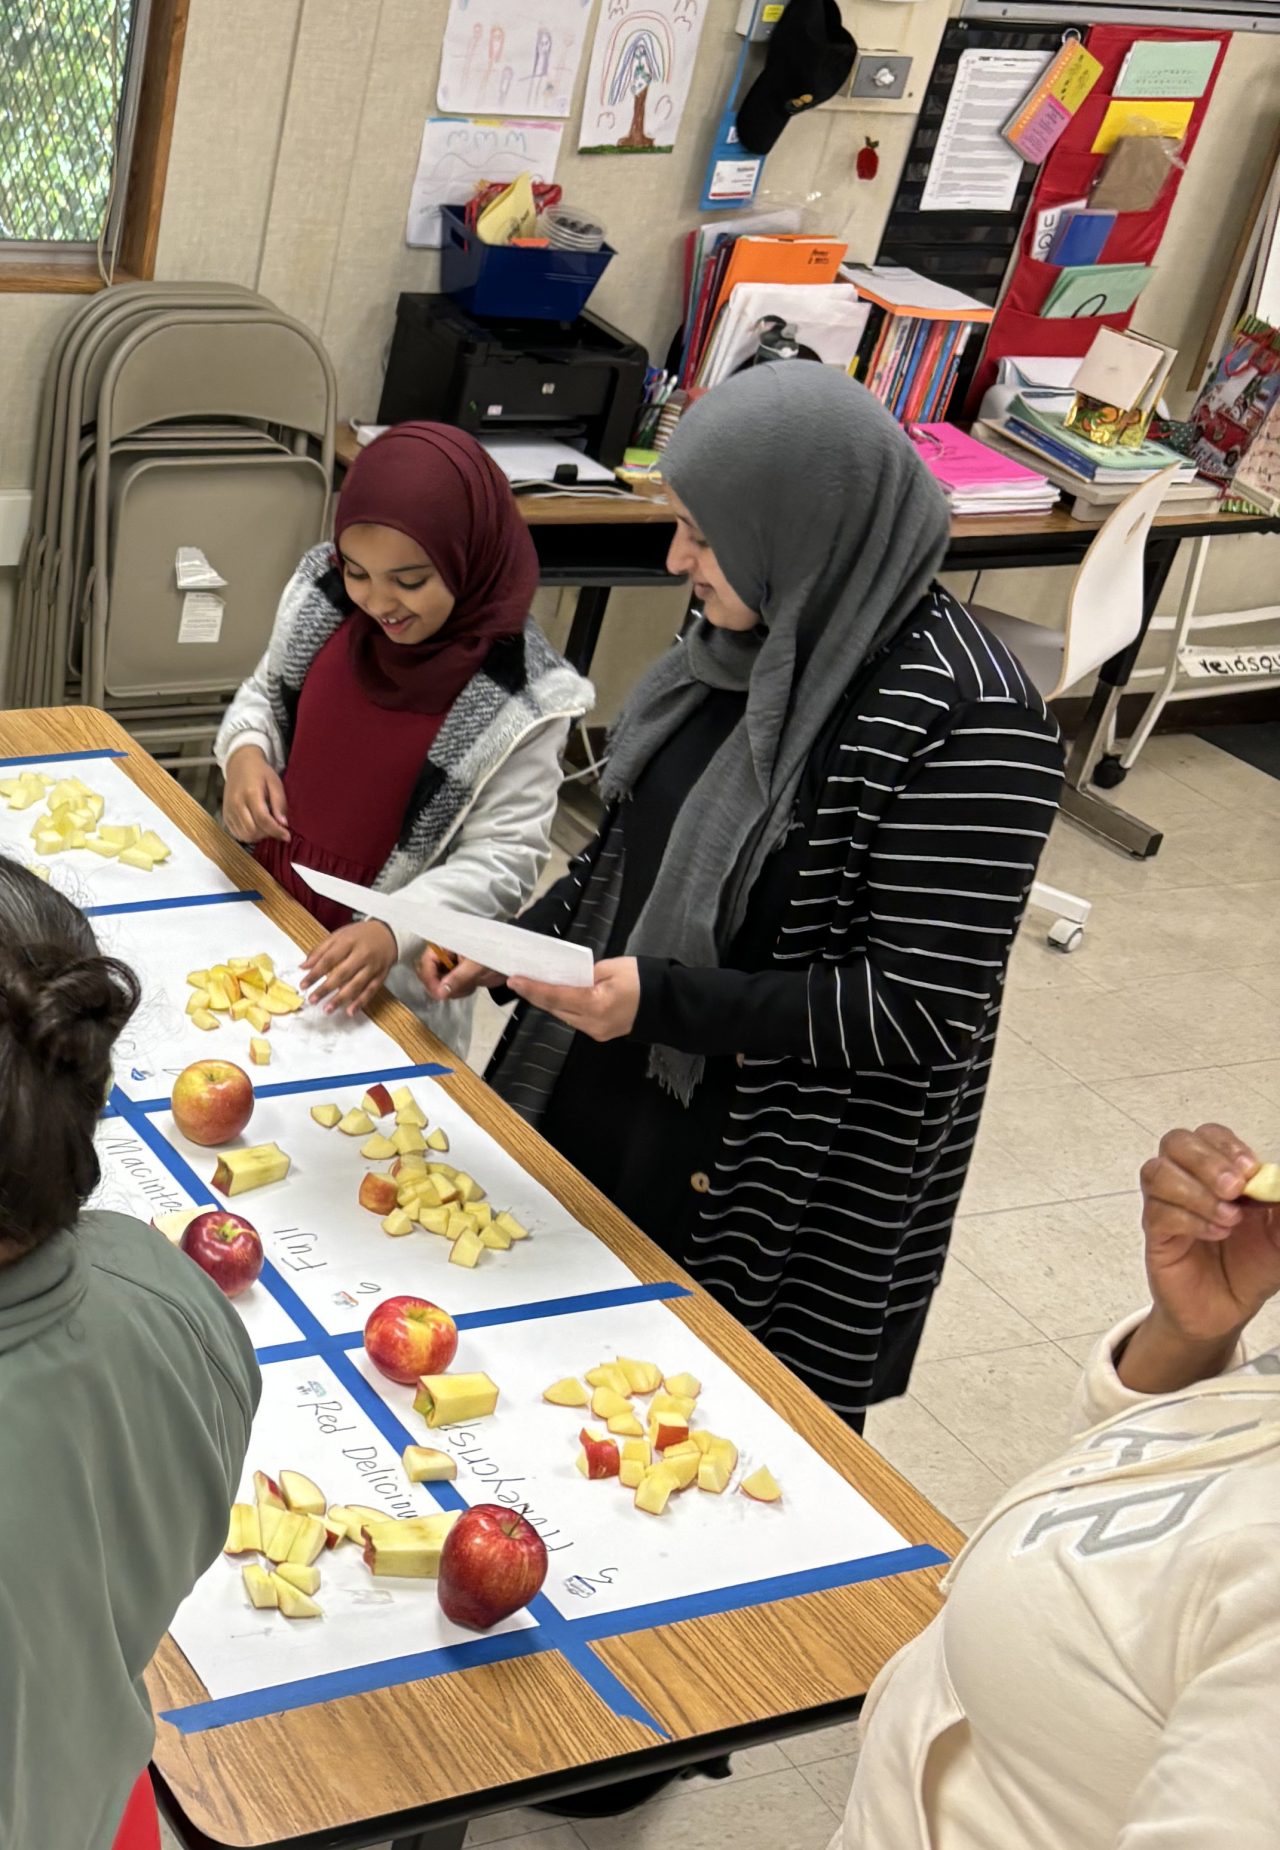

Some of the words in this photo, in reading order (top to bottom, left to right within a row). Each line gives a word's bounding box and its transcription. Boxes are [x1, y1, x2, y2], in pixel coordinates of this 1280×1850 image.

[100, 1138, 182, 1214] Macinto
[273, 1227, 328, 1271] Fuji
[297, 1401, 357, 1434] Red
[342, 1446, 419, 1519] Deliciou
